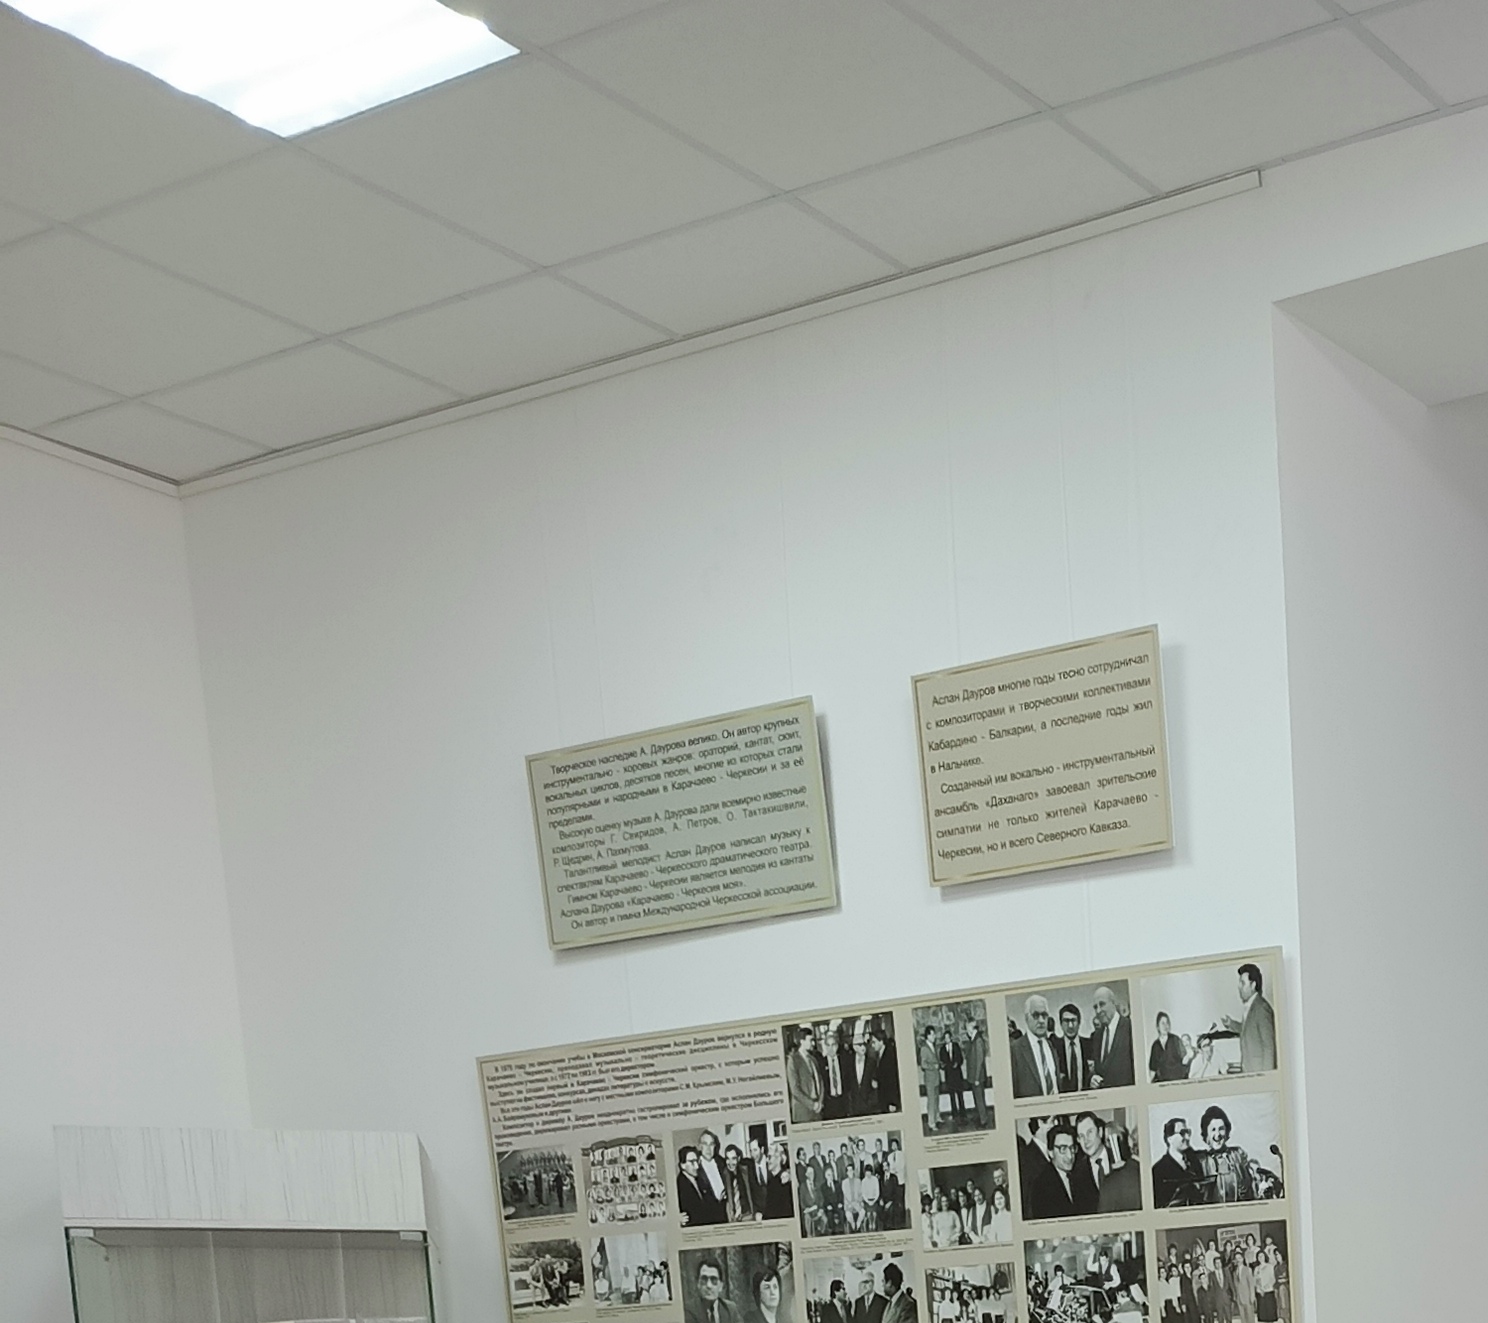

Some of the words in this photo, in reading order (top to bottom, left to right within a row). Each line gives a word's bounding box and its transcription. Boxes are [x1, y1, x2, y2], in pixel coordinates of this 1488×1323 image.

[932, 694, 960, 707] Аслан
[962, 686, 996, 702] Дауров
[998, 679, 1031, 692] многие
[1033, 674, 1056, 686] годы
[1057, 668, 1085, 680] тесно
[1087, 655, 1149, 675] сотрудничал
[935, 707, 1006, 728] композиторами
[1019, 692, 1080, 712] творческими
[1083, 678, 1151, 698] коллективами
[928, 736, 978, 752] Кабардино
[989, 724, 1037, 740] Балкарии,
[1051, 711, 1102, 728] последние
[1106, 705, 1129, 717] годы
[1133, 701, 1153, 712] жил
[934, 802, 979, 818] ансамбль
[1046, 782, 1090, 797] завоевал
[1097, 769, 1157, 789] зрительские
[940, 775, 993, 794] Созданный
[1010, 766, 1054, 781] вокально
[1062, 745, 1156, 771] инструментальный
[936, 824, 982, 839] симпатии
[1006, 814, 1039, 827] только
[1045, 803, 1087, 820] жителей
[1094, 794, 1148, 812] Карачаево
[938, 846, 985, 861] Черкесии,
[1009, 837, 1035, 849] всего
[1036, 828, 1088, 844] Северного
